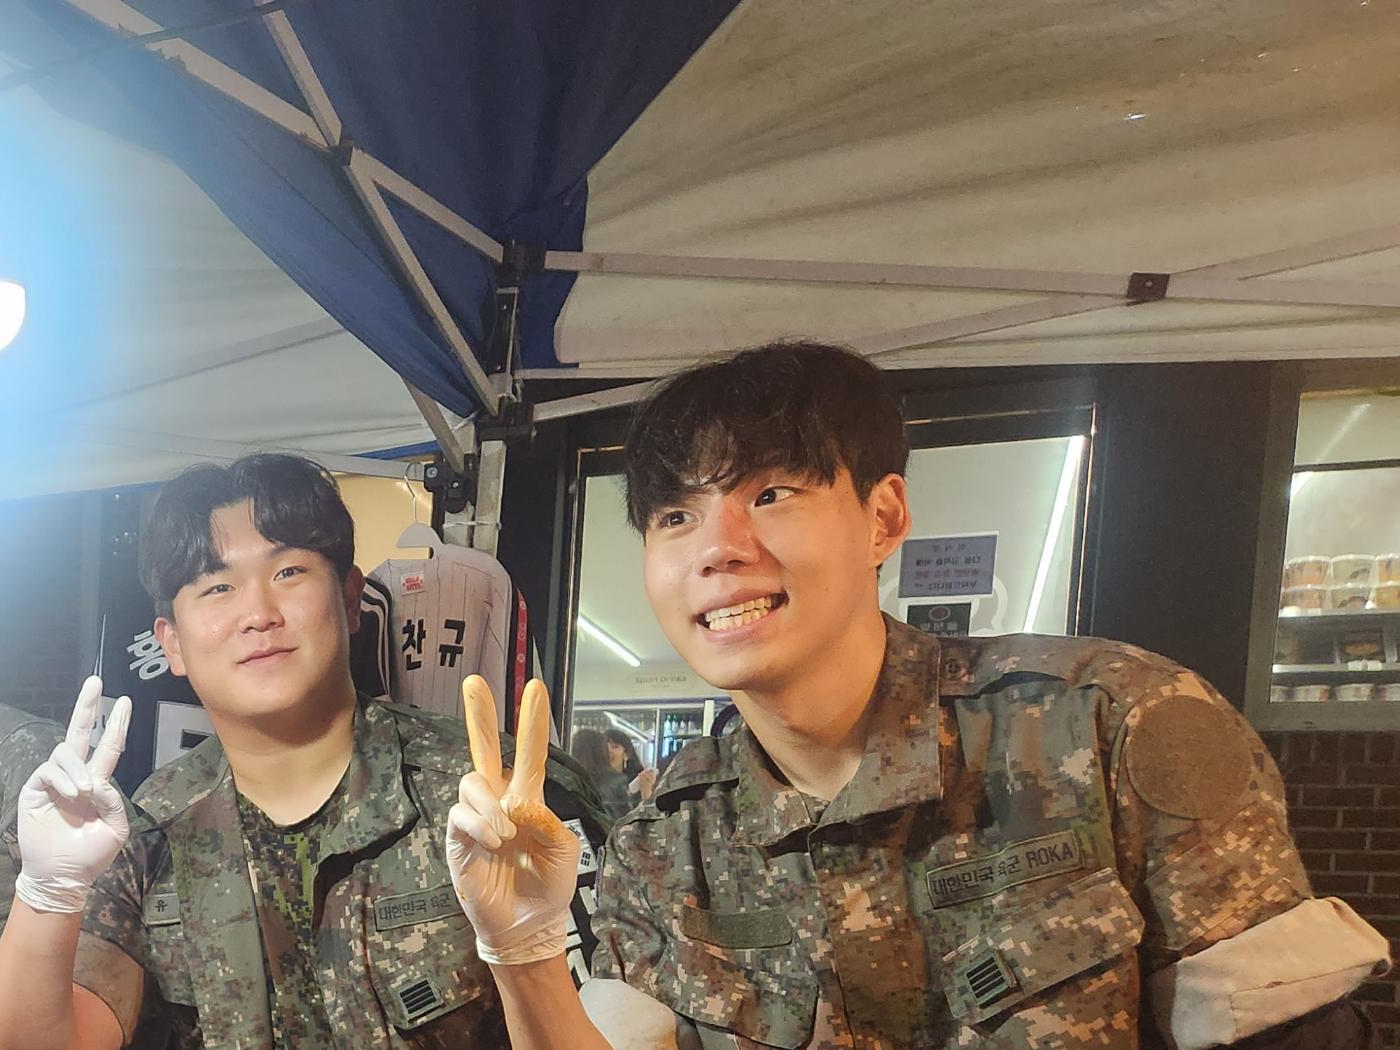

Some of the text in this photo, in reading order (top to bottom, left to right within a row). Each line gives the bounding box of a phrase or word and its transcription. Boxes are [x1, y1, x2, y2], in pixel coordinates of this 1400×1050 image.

[932, 842, 1075, 897] 대한민국 육군 ROKA
[153, 899, 168, 913] 유
[378, 899, 428, 921] 대한민국
